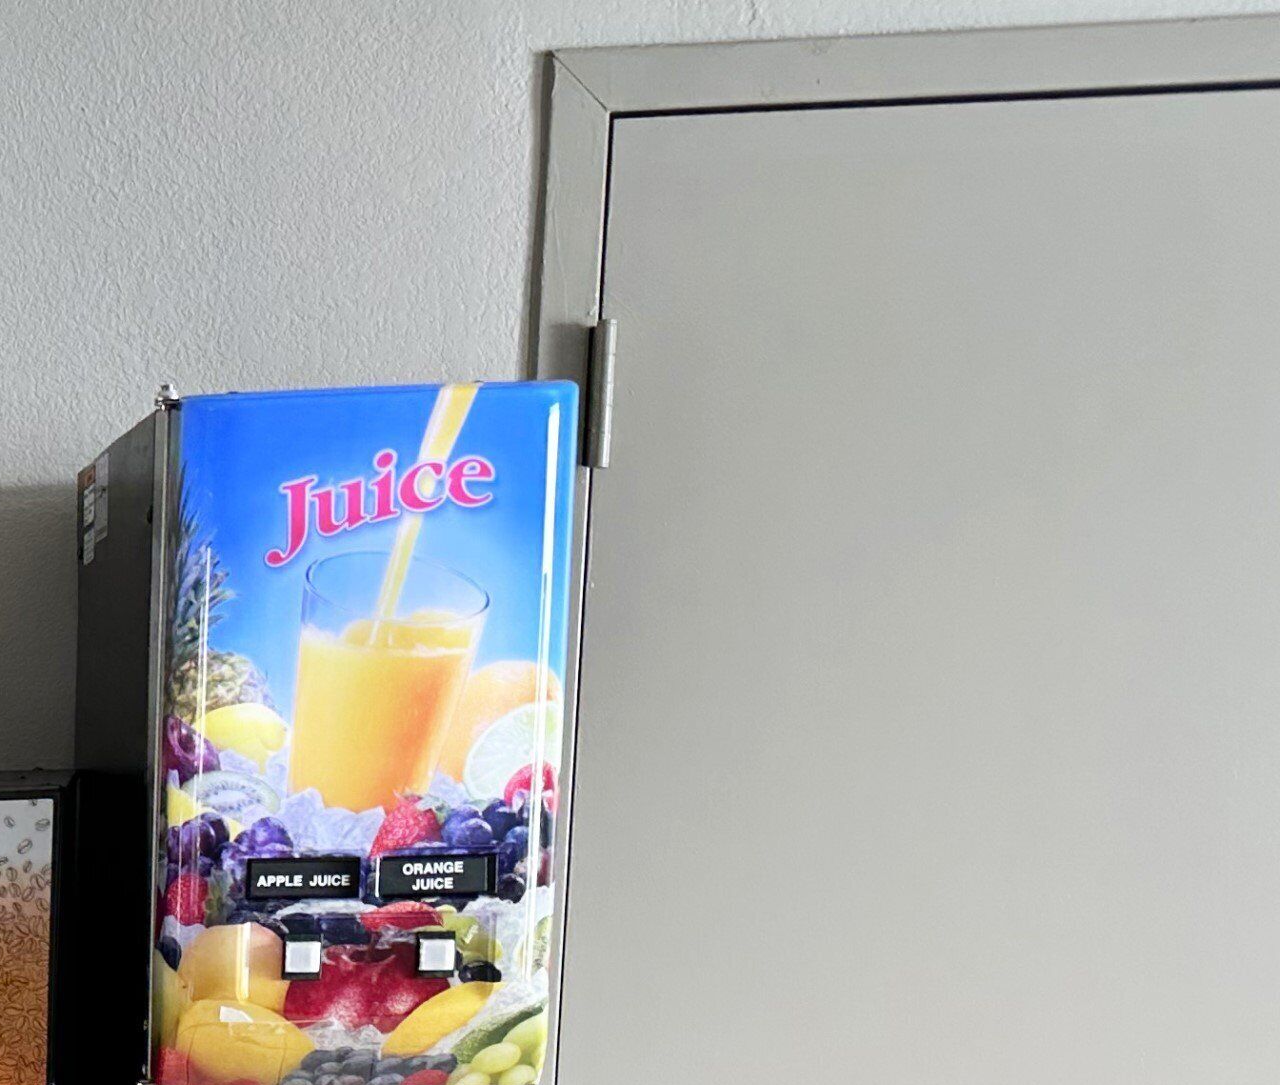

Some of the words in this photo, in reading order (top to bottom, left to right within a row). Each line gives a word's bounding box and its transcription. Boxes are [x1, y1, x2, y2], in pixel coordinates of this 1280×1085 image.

[264, 448, 495, 567] Juice
[402, 861, 464, 876] ORANGE
[256, 874, 303, 888] APPLE
[309, 874, 351, 887] JUICE
[412, 877, 454, 891] JUICE
